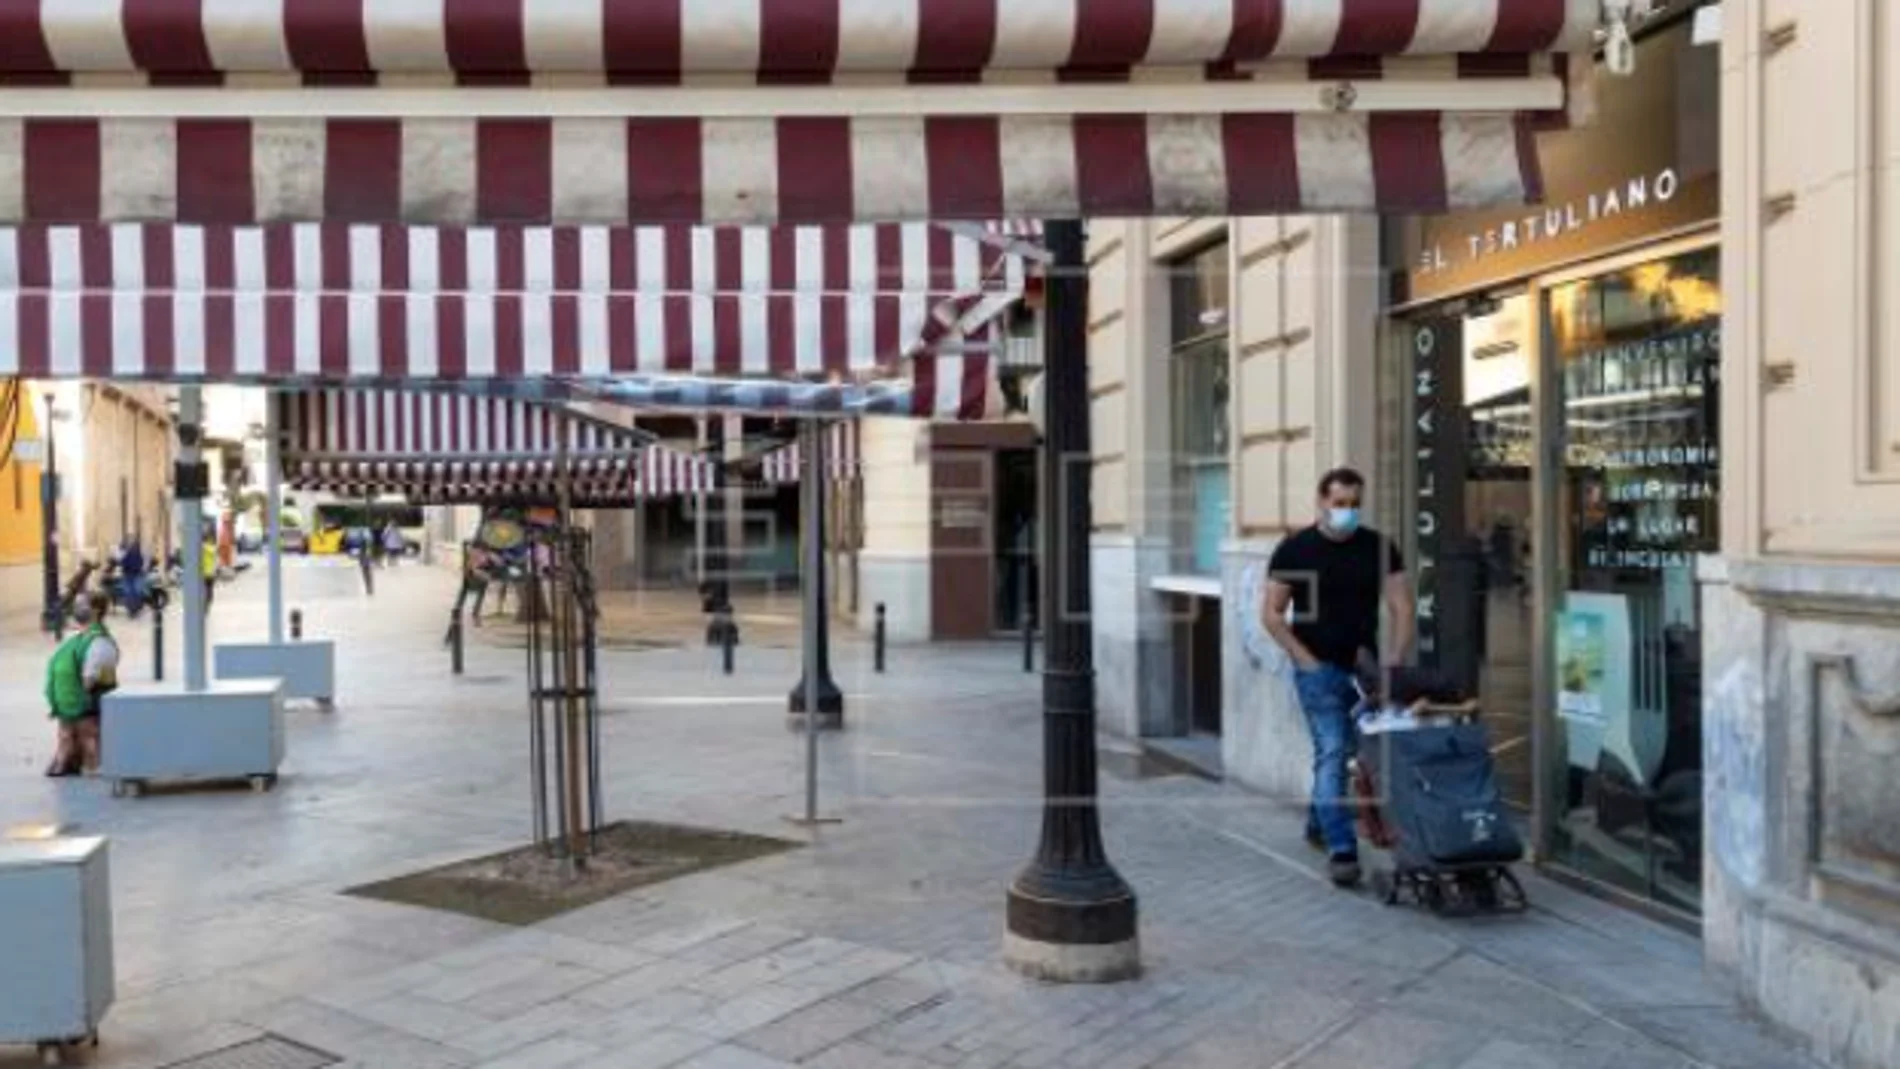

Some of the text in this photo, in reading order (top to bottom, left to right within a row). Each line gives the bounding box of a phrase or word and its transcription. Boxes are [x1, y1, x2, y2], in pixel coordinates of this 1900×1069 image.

[1420, 166, 1680, 277] EL TERTULIANO
[1416, 326, 1436, 652] ERTULIANO
